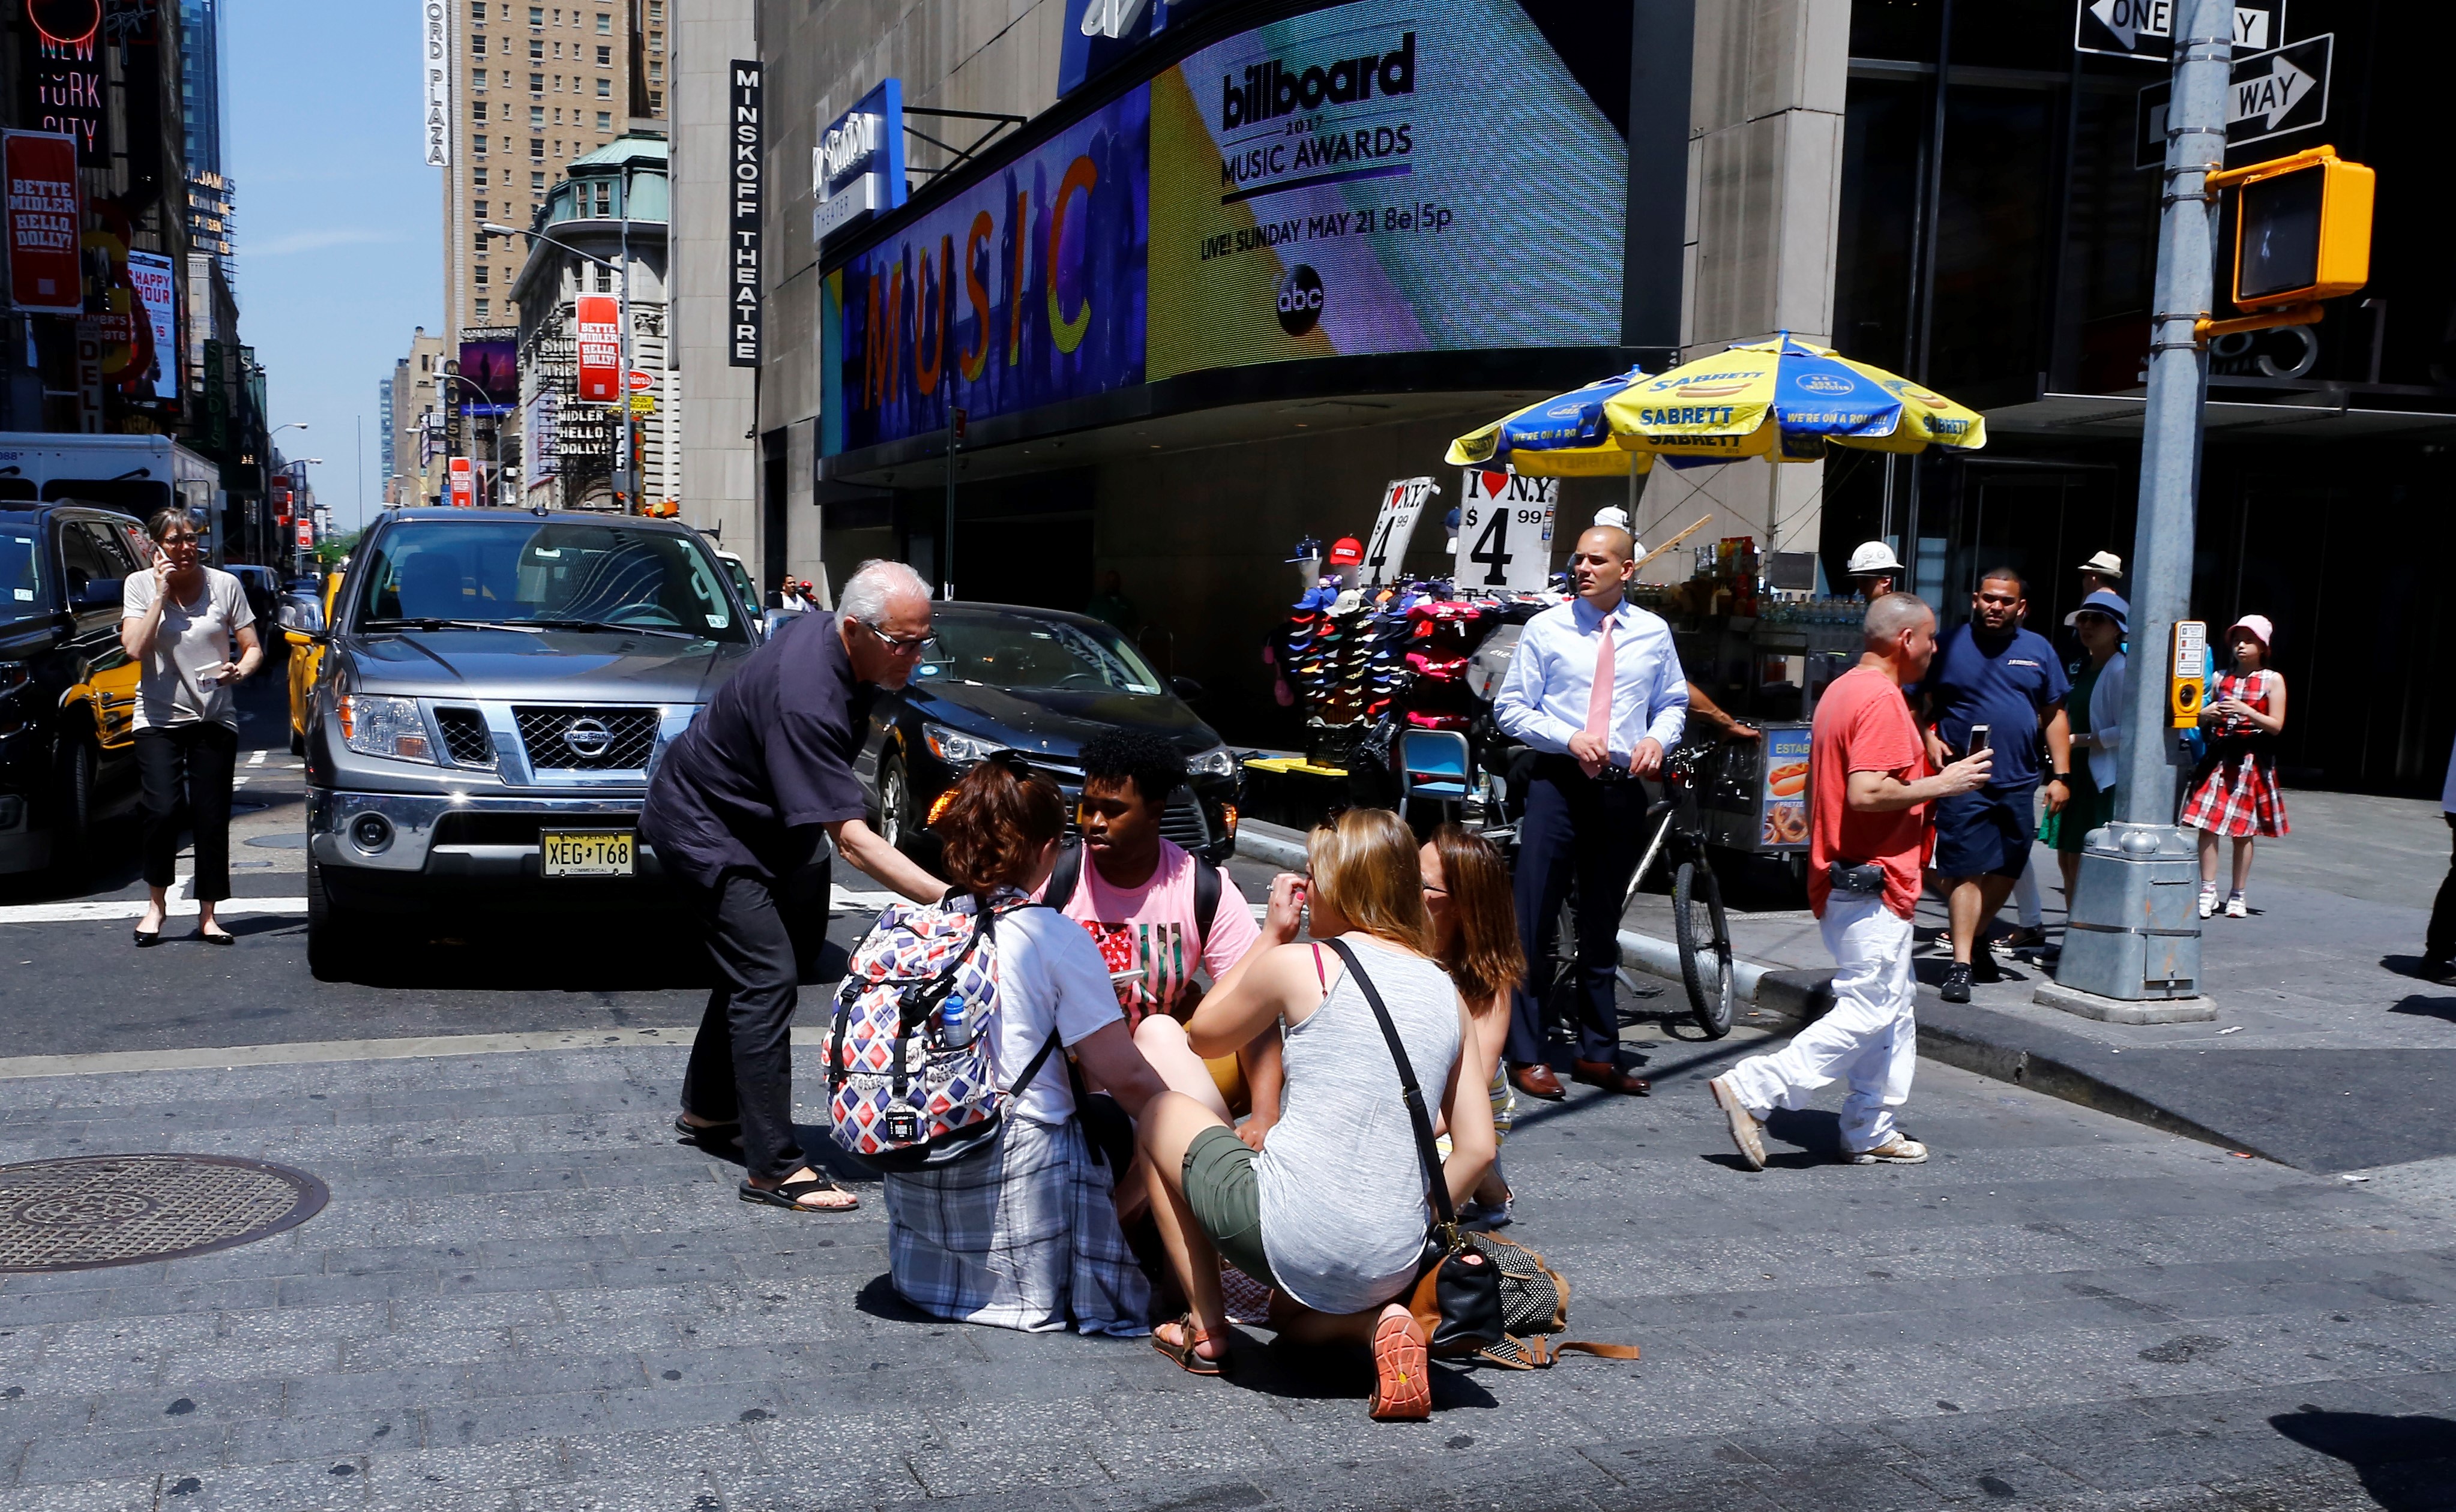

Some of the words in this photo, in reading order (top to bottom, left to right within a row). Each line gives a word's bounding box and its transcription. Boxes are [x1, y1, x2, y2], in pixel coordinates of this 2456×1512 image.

[2111, 0, 2169, 32] ONE
[427, 2, 444, 59] ORD
[1223, 32, 1415, 132] billboard
[2239, 72, 2297, 117] WAY
[427, 68, 445, 164] PLAZA
[736, 69, 758, 218] MINSKOFF
[1221, 145, 1284, 187] MUSIC
[1294, 124, 1413, 170] AWARDS
[13, 179, 71, 197] BETTE
[9, 195, 76, 214] MIDLER
[15, 230, 72, 250] DOLLY!
[1201, 235, 1231, 260] LIVE!
[1236, 219, 1302, 253] SUNDAY
[1308, 212, 1351, 240] MAY
[1355, 208, 1376, 235] 21
[136, 271, 170, 289] HAPPY
[864, 155, 1098, 411] MUSIC
[735, 231, 757, 360] THEATRE
[1277, 281, 1322, 313] abc
[579, 332, 618, 343] MIDLER
[580, 323, 616, 334] BETTE
[582, 354, 616, 367] DOLLY!
[79, 339, 98, 432] DELI
[1648, 371, 1765, 392] SABRETT
[1640, 406, 1734, 426] SABRETT
[1787, 413, 1820, 424] WE'RE
[1823, 413, 1837, 423] ON
[1840, 415, 1847, 424] A
[1513, 431, 1539, 442] WE'RE
[1541, 430, 1553, 439] ON
[1555, 429, 1562, 437] A
[1564, 428, 1577, 437] RO
[560, 443, 606, 455] DOLLY!
[1469, 471, 1479, 498] I
[1383, 488, 1394, 512] I
[1374, 520, 1383, 536] $
[1396, 515, 1409, 528] 99
[1466, 506, 1478, 529] $
[1517, 509, 1542, 530] 99
[1368, 516, 1395, 587] 4
[1470, 508, 1513, 586] 4
[1776, 744, 1811, 754] ESTAB
[550, 843, 582, 865] XEG
[595, 843, 628, 865] T68
